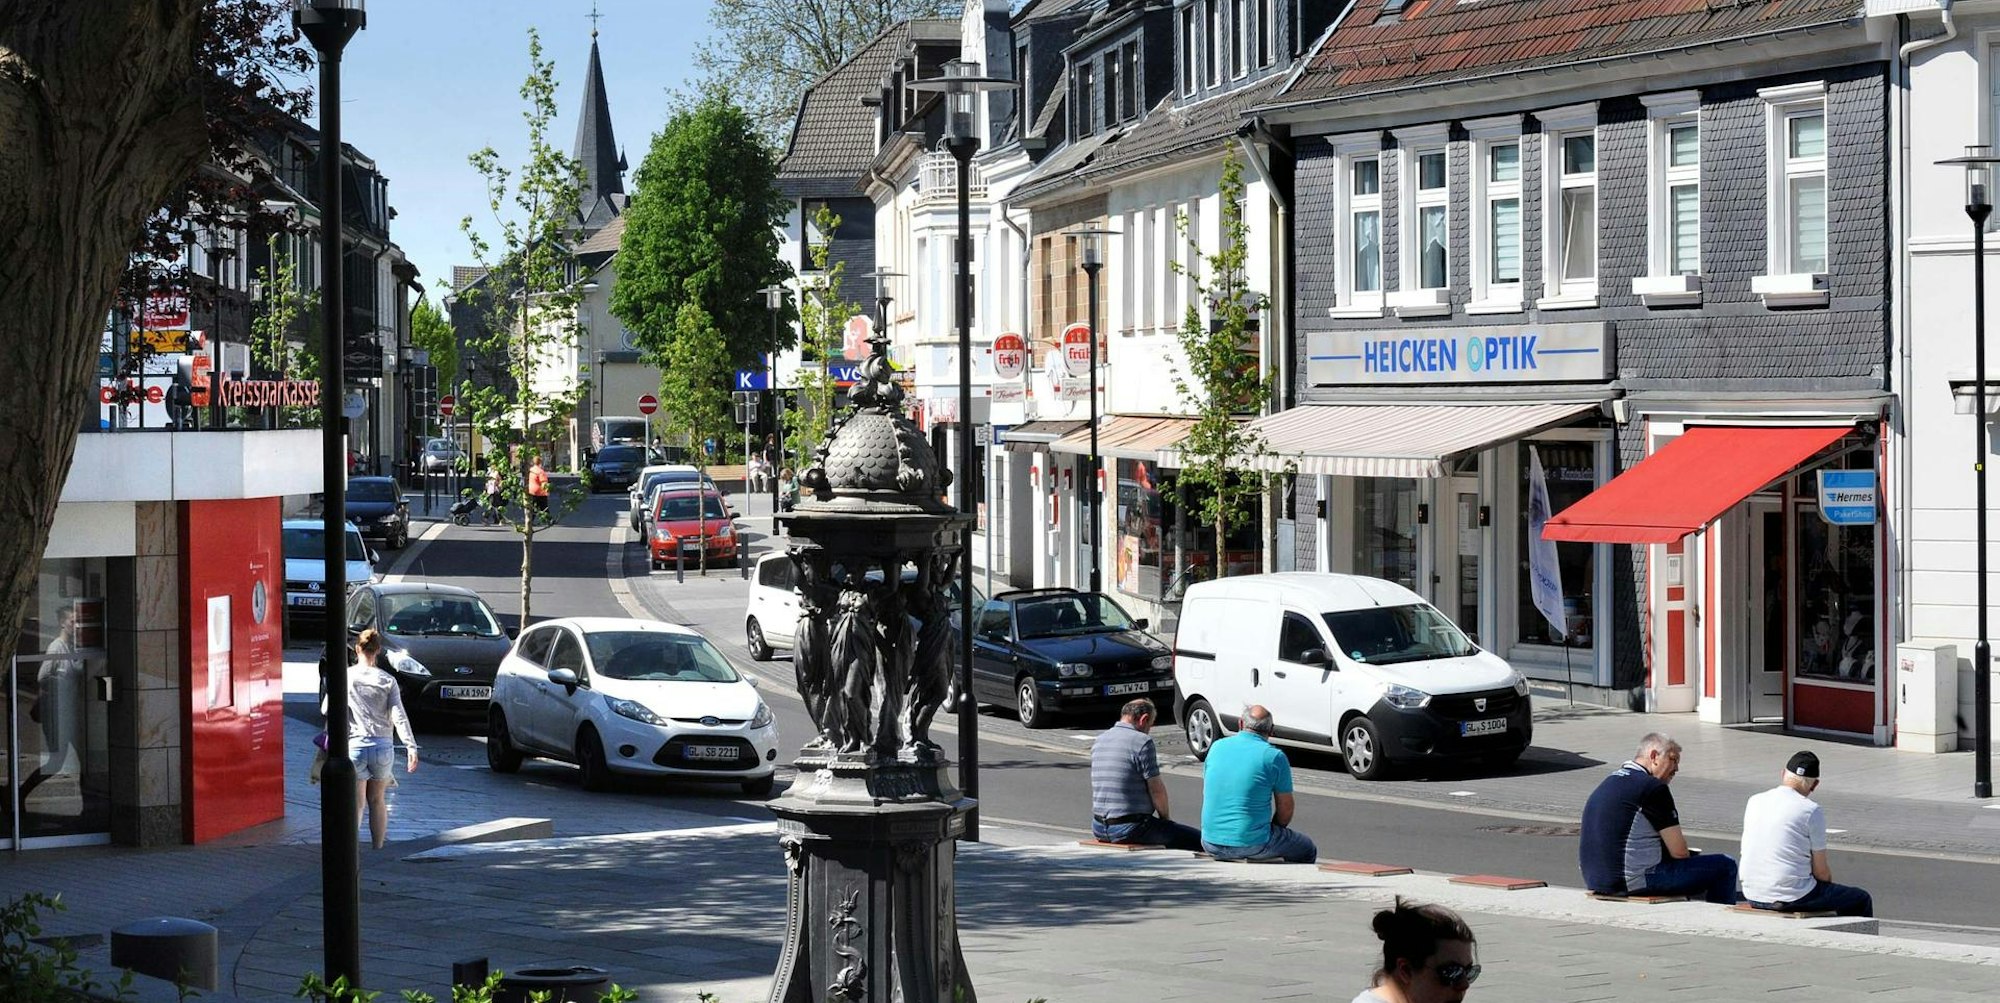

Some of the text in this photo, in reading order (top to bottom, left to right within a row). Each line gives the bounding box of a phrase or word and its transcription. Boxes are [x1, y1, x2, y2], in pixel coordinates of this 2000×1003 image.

[1365, 335, 1538, 373] HEICKEN OPTIK
[218, 372, 320, 415] Kreissparkasse
[1836, 492, 1873, 502] Hermes
[1487, 719, 1506, 730] 1004
